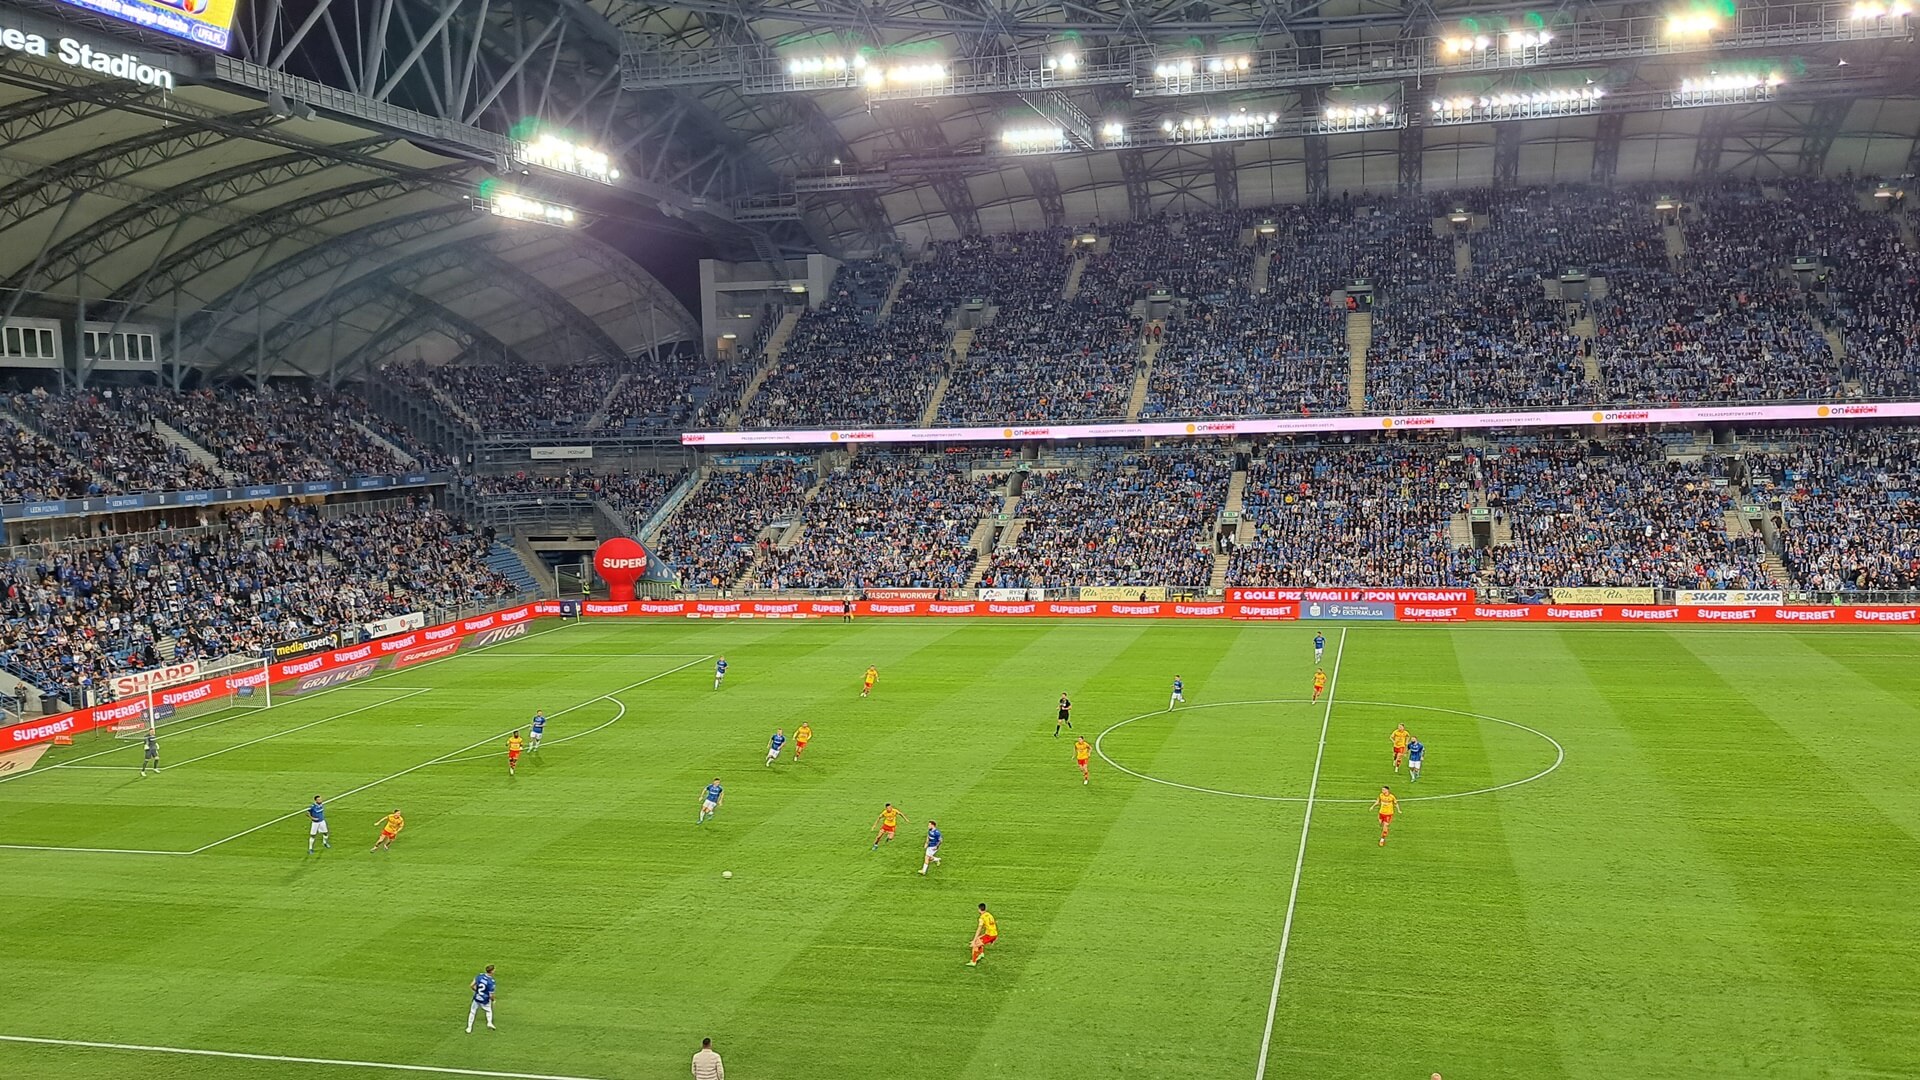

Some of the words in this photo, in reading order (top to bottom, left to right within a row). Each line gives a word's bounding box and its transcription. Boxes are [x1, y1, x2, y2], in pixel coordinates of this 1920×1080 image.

[58, 37, 174, 89] Stadion
[1233, 591, 1241, 600] 2
[1243, 591, 1275, 600] GOLE
[1398, 591, 1467, 602] WYGRANY!
[586, 604, 628, 613] SUPERBET
[641, 604, 684, 613] SUPERBET
[697, 603, 741, 613] SUPERBET
[754, 603, 799, 613] SUPERBET
[870, 604, 915, 614] SUPERBET
[929, 604, 975, 614] SUPERBET
[989, 604, 1035, 614] SUPERBET
[1049, 604, 1097, 614] SUPERBET
[1112, 605, 1160, 614] SUPERBET
[1175, 605, 1225, 615] SUPERBET
[1240, 606, 1291, 616] SUPERBET
[1404, 607, 1458, 617] SUPERBET
[1475, 607, 1530, 618] SUPERBET
[1547, 608, 1603, 618] SUPERBET
[1621, 608, 1679, 619] SUPERBET
[501, 608, 528, 622] SUPERBET
[1698, 609, 1757, 619] SUPERBET
[1775, 609, 1836, 620] SUPERBET
[1855, 610, 1916, 621] SUPERBET
[464, 616, 494, 631] SUPERBET
[425, 625, 457, 641] SUPERBET
[381, 635, 416, 651] SUPERBET
[334, 645, 372, 662] SUPERBET
[403, 643, 456, 662] SUPERBET
[282, 657, 323, 675] SUPERBET
[117, 664, 195, 696] SHARP
[302, 674, 333, 690] GRAJ
[162, 684, 212, 705] SUPERBET
[92, 700, 148, 722] SUPERBET
[13, 717, 75, 741] SUPERBET
[478, 983, 486, 996] 2
